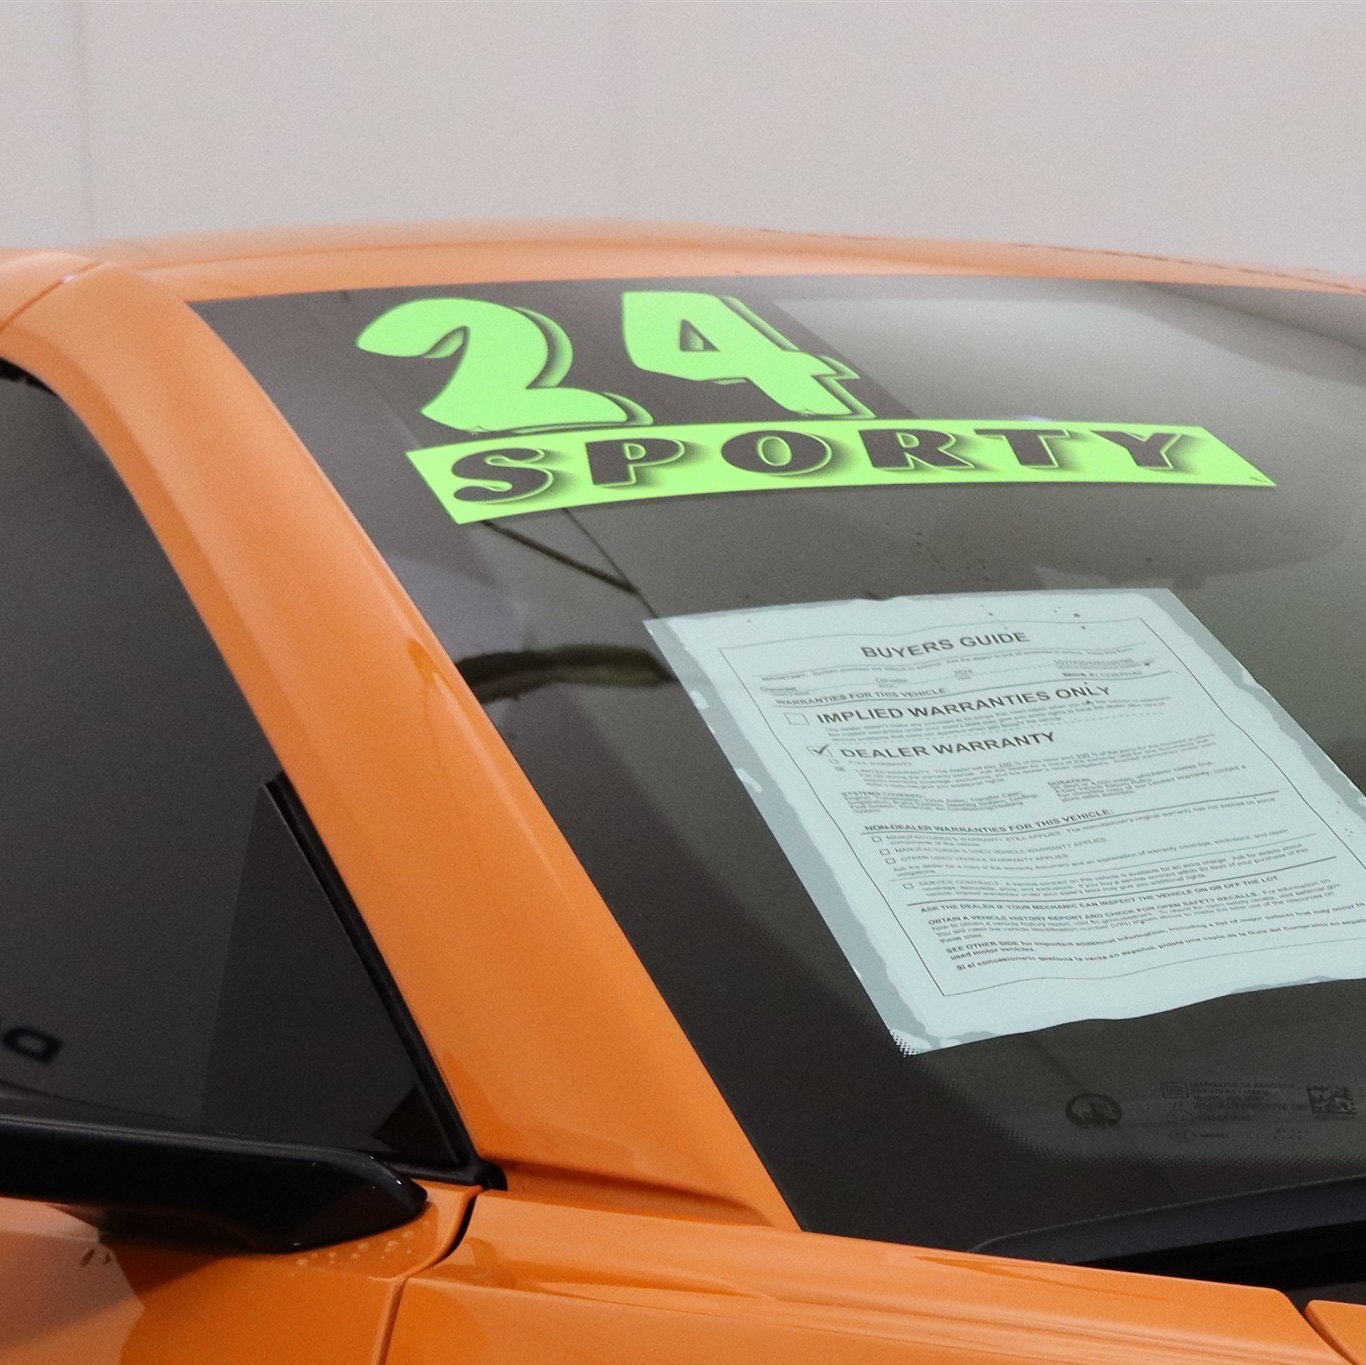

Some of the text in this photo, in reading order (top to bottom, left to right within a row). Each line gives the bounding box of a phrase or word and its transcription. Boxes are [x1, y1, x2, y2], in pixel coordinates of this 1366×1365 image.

[355, 290, 873, 430] 24
[451, 427, 1199, 505] SPORTY
[858, 631, 1031, 657] BUYERS GUIDE
[774, 694, 848, 705] WARRANTIES
[847, 691, 873, 699] FOR
[814, 684, 1115, 724] IMPLIED WARRANTIES ONLY
[838, 731, 1060, 759] DEALER WARRANTY
[932, 824, 1008, 832] WARRANTIES
[1007, 822, 1034, 831] FOR
[1034, 818, 1062, 828] THIS
